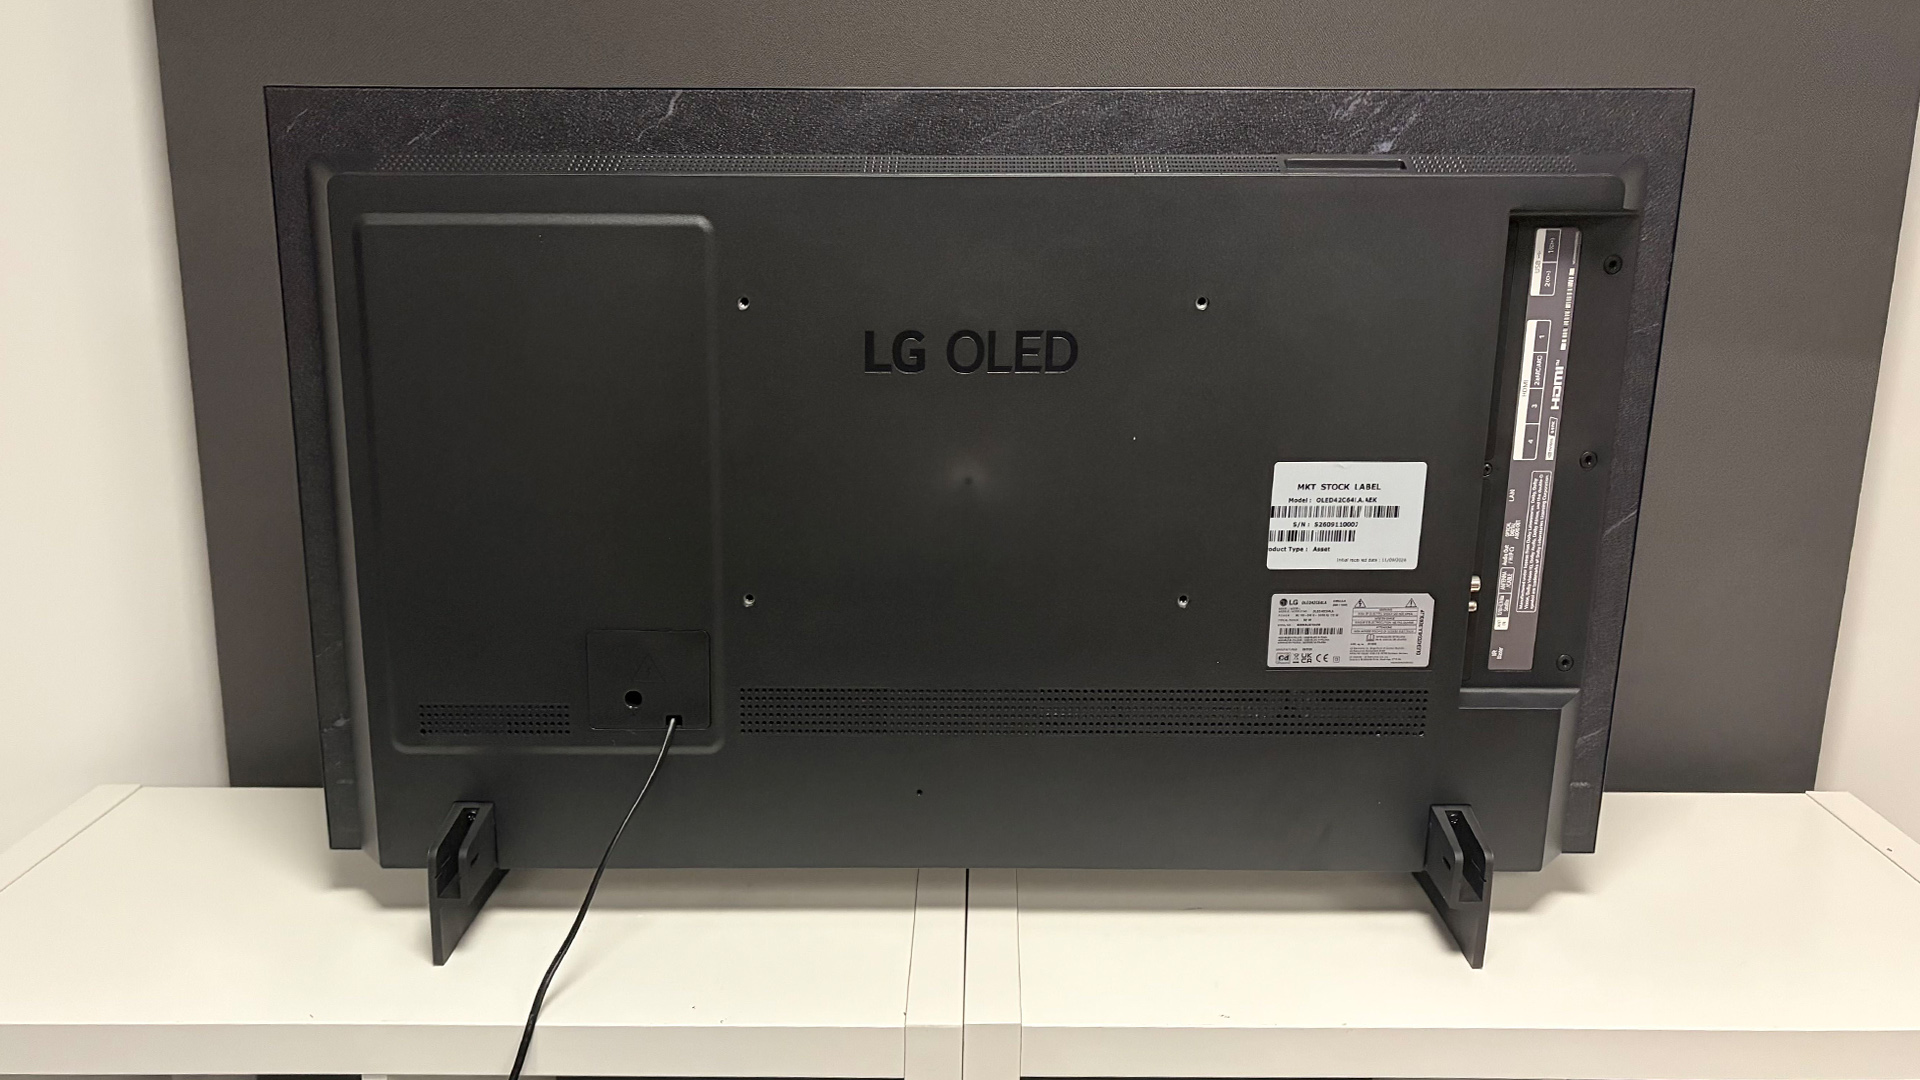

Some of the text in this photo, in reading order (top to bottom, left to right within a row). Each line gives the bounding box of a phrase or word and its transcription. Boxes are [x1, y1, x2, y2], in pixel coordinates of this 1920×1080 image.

[864, 329, 1079, 375] LG OLED
[1316, 653, 1329, 662] CE
